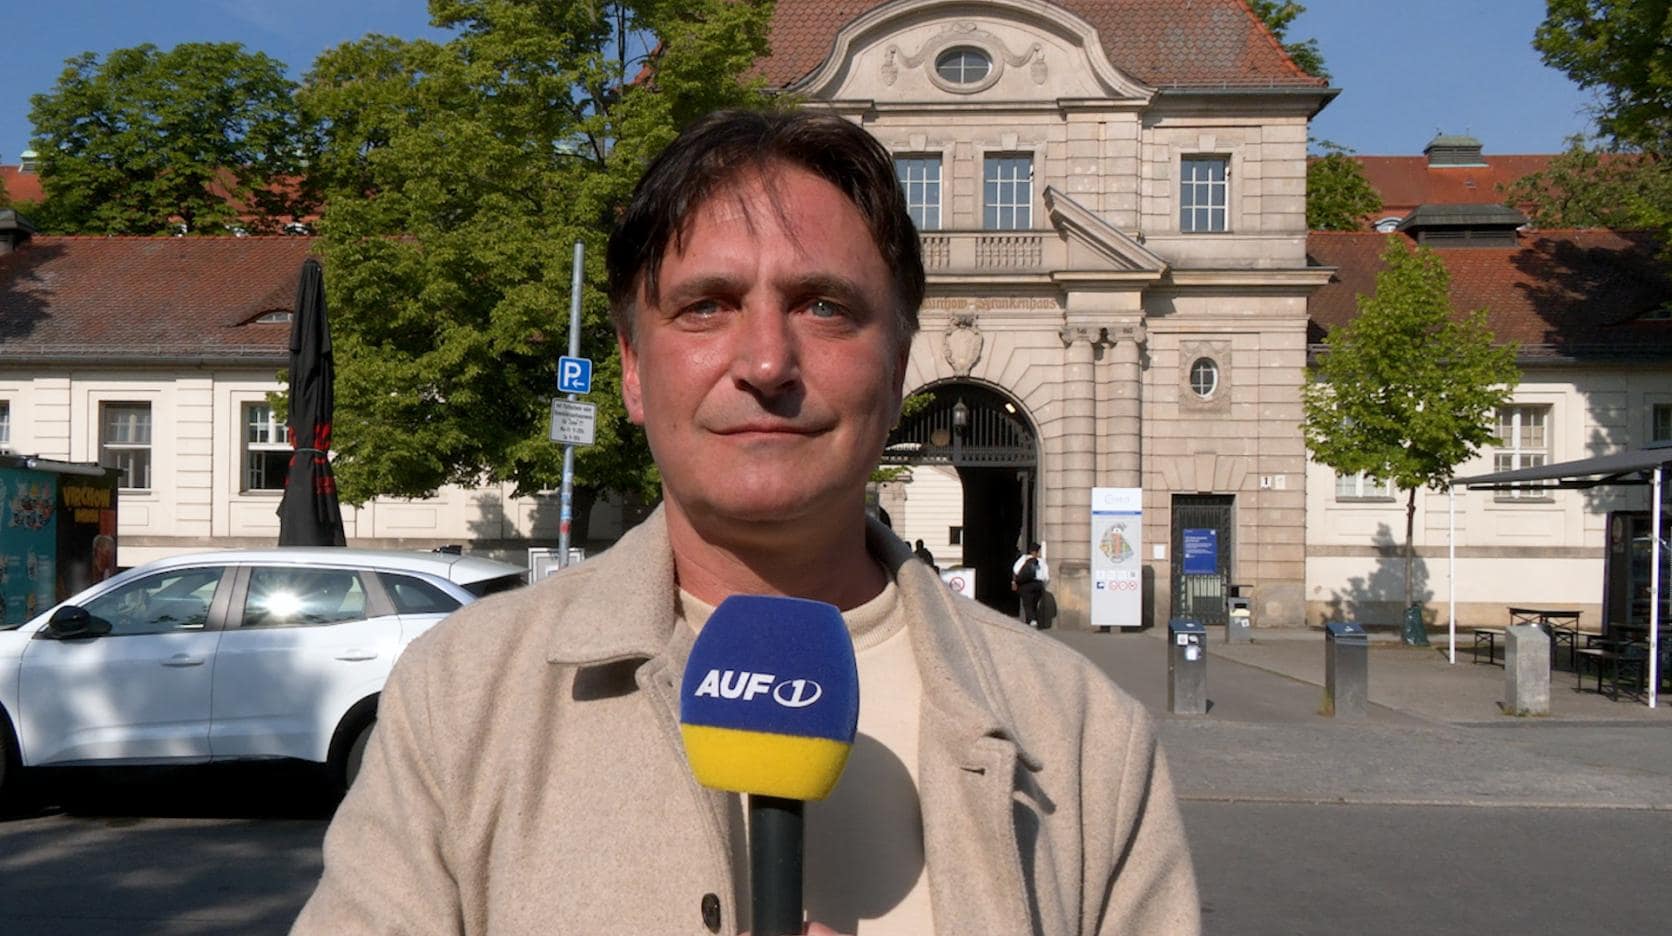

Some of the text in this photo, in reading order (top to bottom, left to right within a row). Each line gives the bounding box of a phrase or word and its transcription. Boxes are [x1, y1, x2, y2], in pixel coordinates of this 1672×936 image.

[563, 361, 581, 387] P
[63, 486, 111, 507] VIRCHOW
[694, 669, 775, 700] AUF
